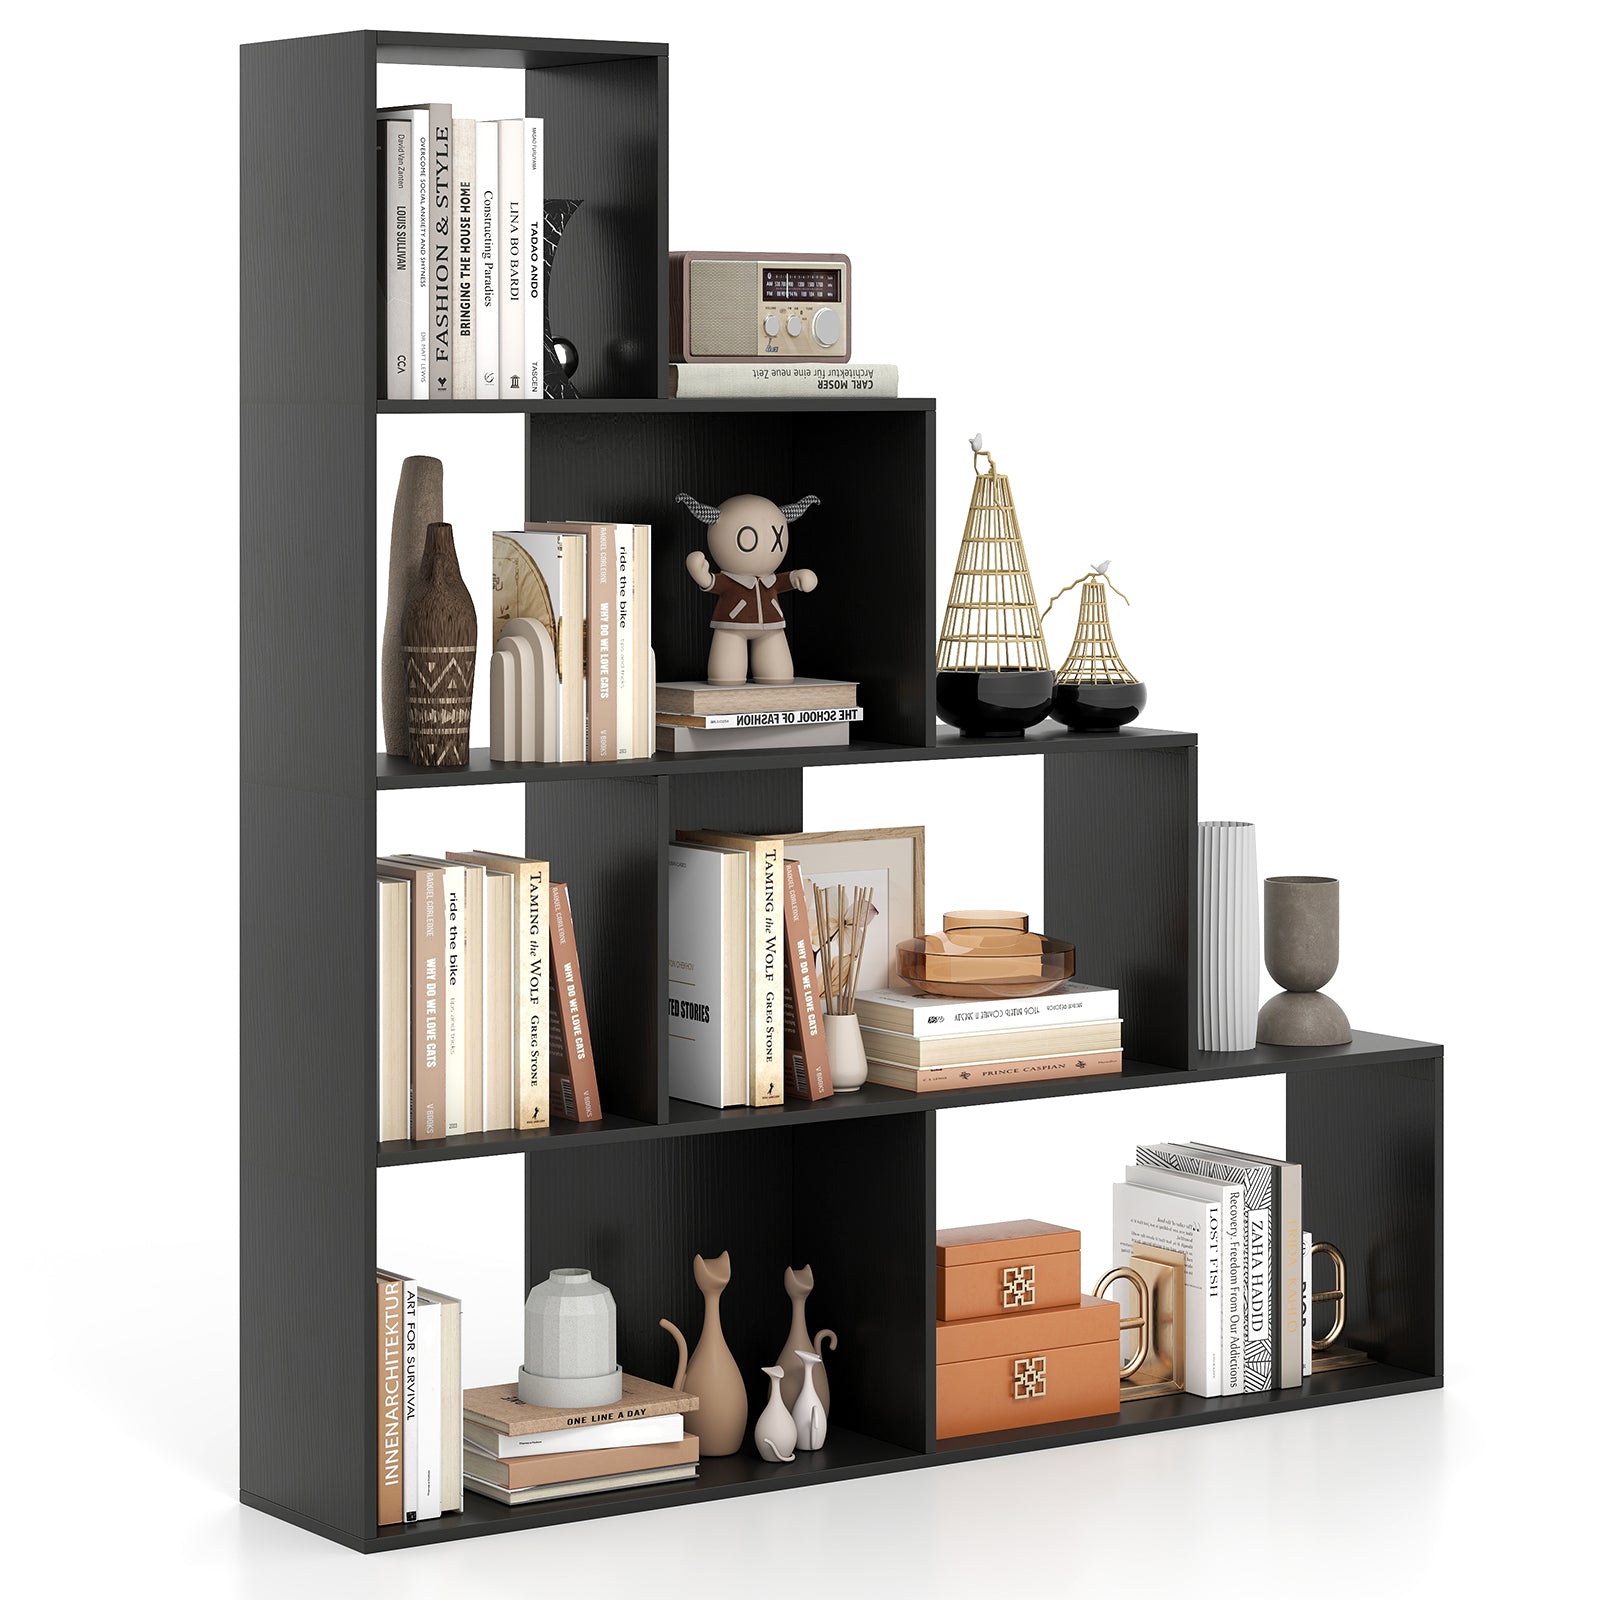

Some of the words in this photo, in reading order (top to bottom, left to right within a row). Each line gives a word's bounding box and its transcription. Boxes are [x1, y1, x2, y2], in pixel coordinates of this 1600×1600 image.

[397, 134, 405, 152] David
[397, 153, 405, 164] Van
[435, 127, 449, 208] STYLE
[397, 165, 405, 189] Zanten
[460, 182, 471, 214] HOME
[396, 205, 406, 229] LOUIS
[435, 217, 449, 236] &
[482, 190, 494, 259] Constructing
[510, 202, 519, 233] LINA
[460, 217, 471, 253] HOUSE
[510, 237, 519, 256] BO
[530, 222, 539, 261] TADAO
[396, 231, 406, 270] SULLIVAN
[460, 257, 471, 279] THE
[510, 259, 519, 301] BARDI
[484, 262, 494, 307] Paradies
[530, 265, 539, 298] ANDO
[435, 245, 449, 362] FASHION
[460, 282, 471, 336] BRINGING
[396, 354, 406, 374] CCA
[753, 369, 769, 379] Zeit
[772, 369, 791, 379] neue
[794, 369, 811, 379] eine
[813, 369, 826, 379] für
[828, 369, 874, 379] Architektur
[818, 380, 848, 390] MOSER
[851, 380, 874, 390] CARL
[600, 602, 609, 620] WHY
[600, 624, 609, 637] DO
[600, 638, 609, 652] WE
[600, 653, 609, 675] LOVE
[600, 676, 609, 699] CATS
[426, 872, 434, 900] RAQUEL
[765, 849, 777, 912] TAMING
[529, 871, 542, 935] TAMING
[765, 935, 777, 982] WOLF
[797, 939, 807, 960] WHY
[426, 957, 436, 981] WHY
[564, 961, 574, 982] WHY
[800, 960, 809, 974] DO
[426, 983, 436, 997] DO
[529, 959, 542, 1005] WOLF
[567, 984, 576, 998] DO
[802, 975, 811, 990] WE
[426, 998, 436, 1015] WE
[569, 998, 579, 1014] WE
[680, 1000, 710, 1024] STORIES
[766, 991, 775, 1023] GREG
[804, 990, 815, 1013] LOVE
[426, 1016, 436, 1041] LOVE
[531, 1015, 540, 1047] GREG
[571, 1014, 582, 1036] LOVE
[808, 1014, 818, 1037] CATS
[426, 1043, 436, 1068] CATS
[575, 1037, 586, 1060] CATS
[766, 1026, 775, 1063] STONE
[531, 1050, 540, 1087] STONE
[982, 1067, 1019, 1077] PRINCE
[1023, 1063, 1066, 1074] CASPIAN
[1226, 1191, 1240, 1240] Recovery.
[1209, 1208, 1218, 1253] LOST
[1251, 1220, 1264, 1270] ZAHA
[1287, 1220, 1298, 1267] FRIDA
[1230, 1241, 1240, 1285] Freedom
[1209, 1258, 1218, 1297] FISH
[407, 1290, 416, 1316] ART
[1230, 1286, 1240, 1312] From
[1251, 1274, 1264, 1332] HADID
[1287, 1277, 1299, 1333] KAHLO
[1230, 1314, 1240, 1334] Our
[407, 1322, 416, 1351] FOR
[1230, 1335, 1240, 1388] Addictions
[385, 1282, 399, 1485] INNENARCHITEKTUR
[406, 1357, 416, 1421] SURVIVAL
[566, 1416, 587, 1426] ONE
[592, 1413, 614, 1423] LINE
[627, 1408, 647, 1418] DAY
